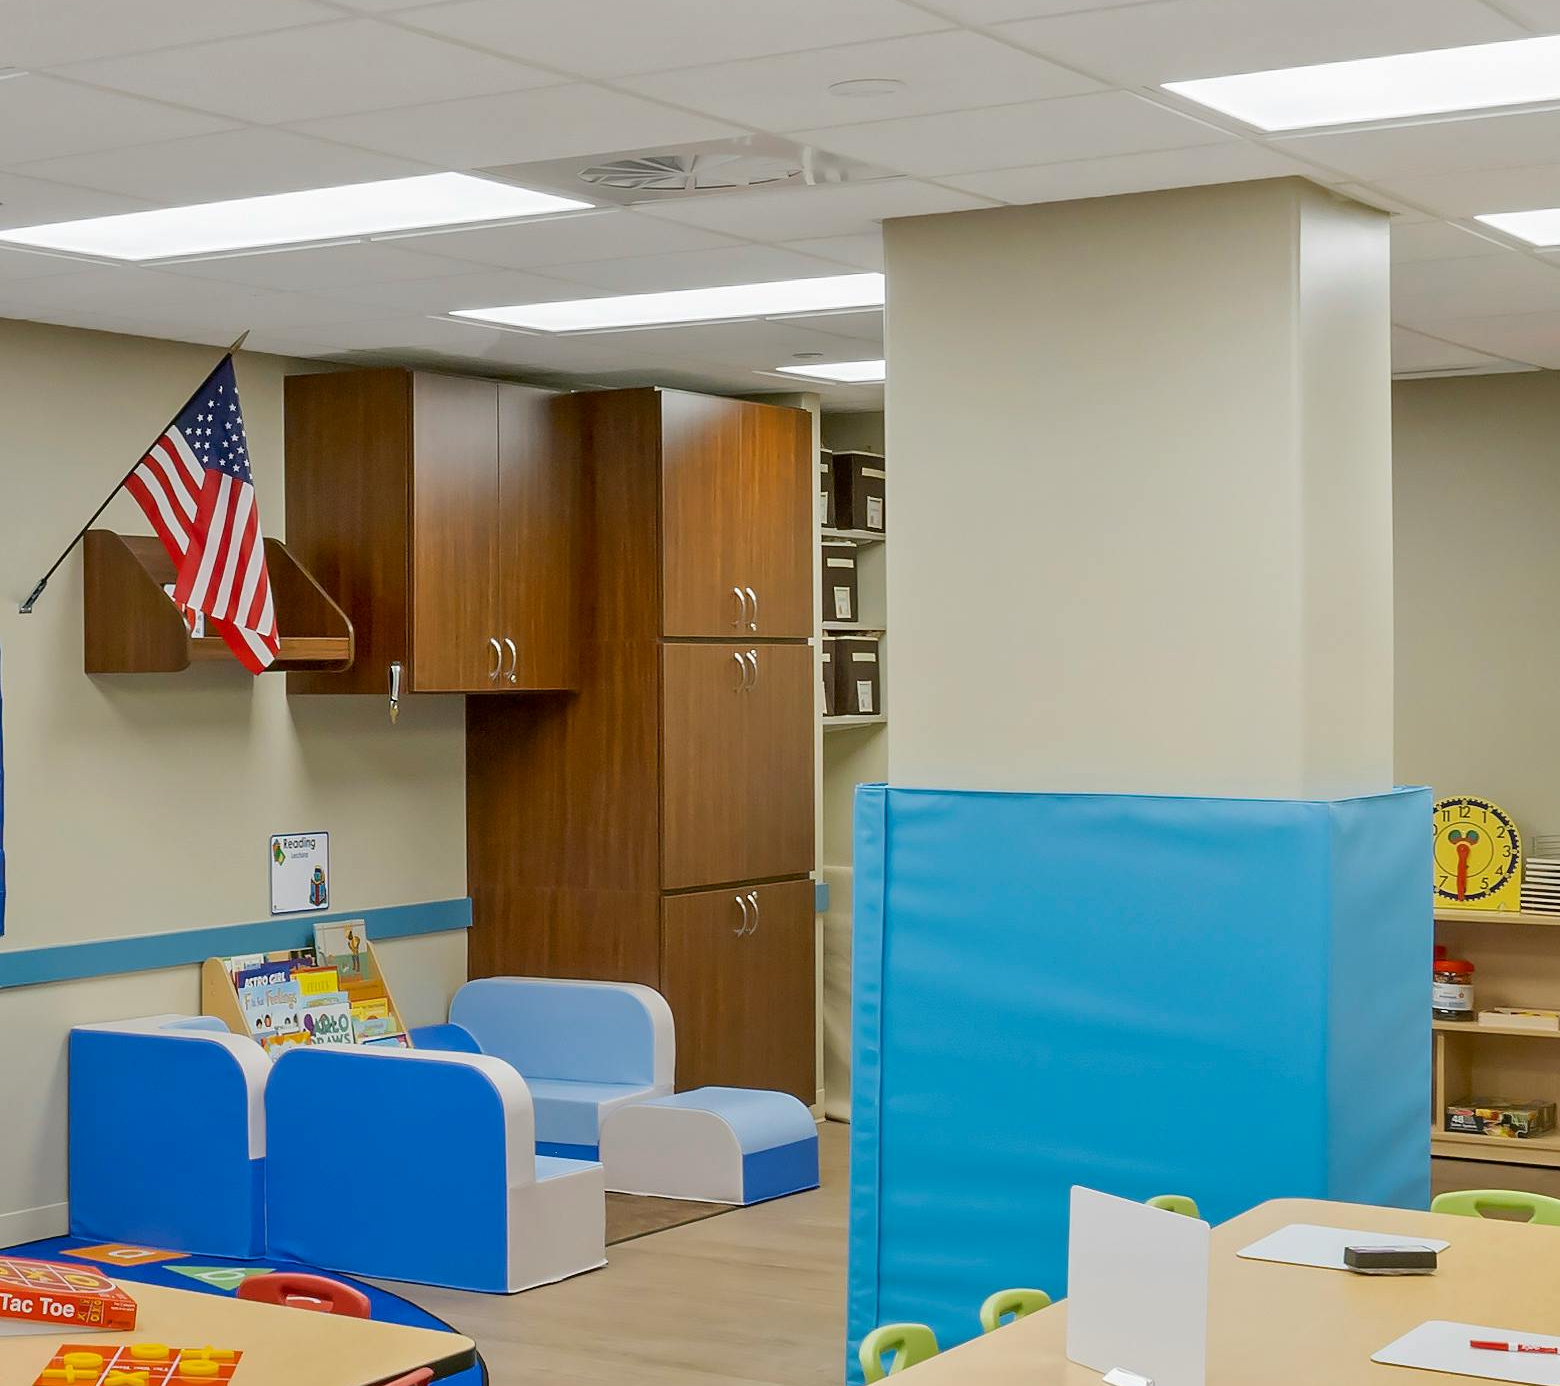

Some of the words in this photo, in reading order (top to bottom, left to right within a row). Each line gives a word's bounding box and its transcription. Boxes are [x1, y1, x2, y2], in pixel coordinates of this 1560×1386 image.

[1442, 810, 1450, 822] 11
[1459, 806, 1471, 818] 12
[1482, 811, 1487, 823] 1
[1497, 825, 1505, 838] 2
[283, 837, 316, 850] Reading
[1502, 845, 1511, 858] 3
[1496, 865, 1503, 875] 4
[1439, 876, 1449, 888] 7
[1480, 877, 1489, 890] 5
[245, 975, 268, 988] ASTRO
[269, 971, 286, 983] GIRL
[244, 993, 251, 1010] F
[265, 989, 297, 1010] Feelings
[1452, 1115, 1463, 1124] 48
[0, 1292, 33, 1314] Tac
[40, 1297, 75, 1318] Toe
